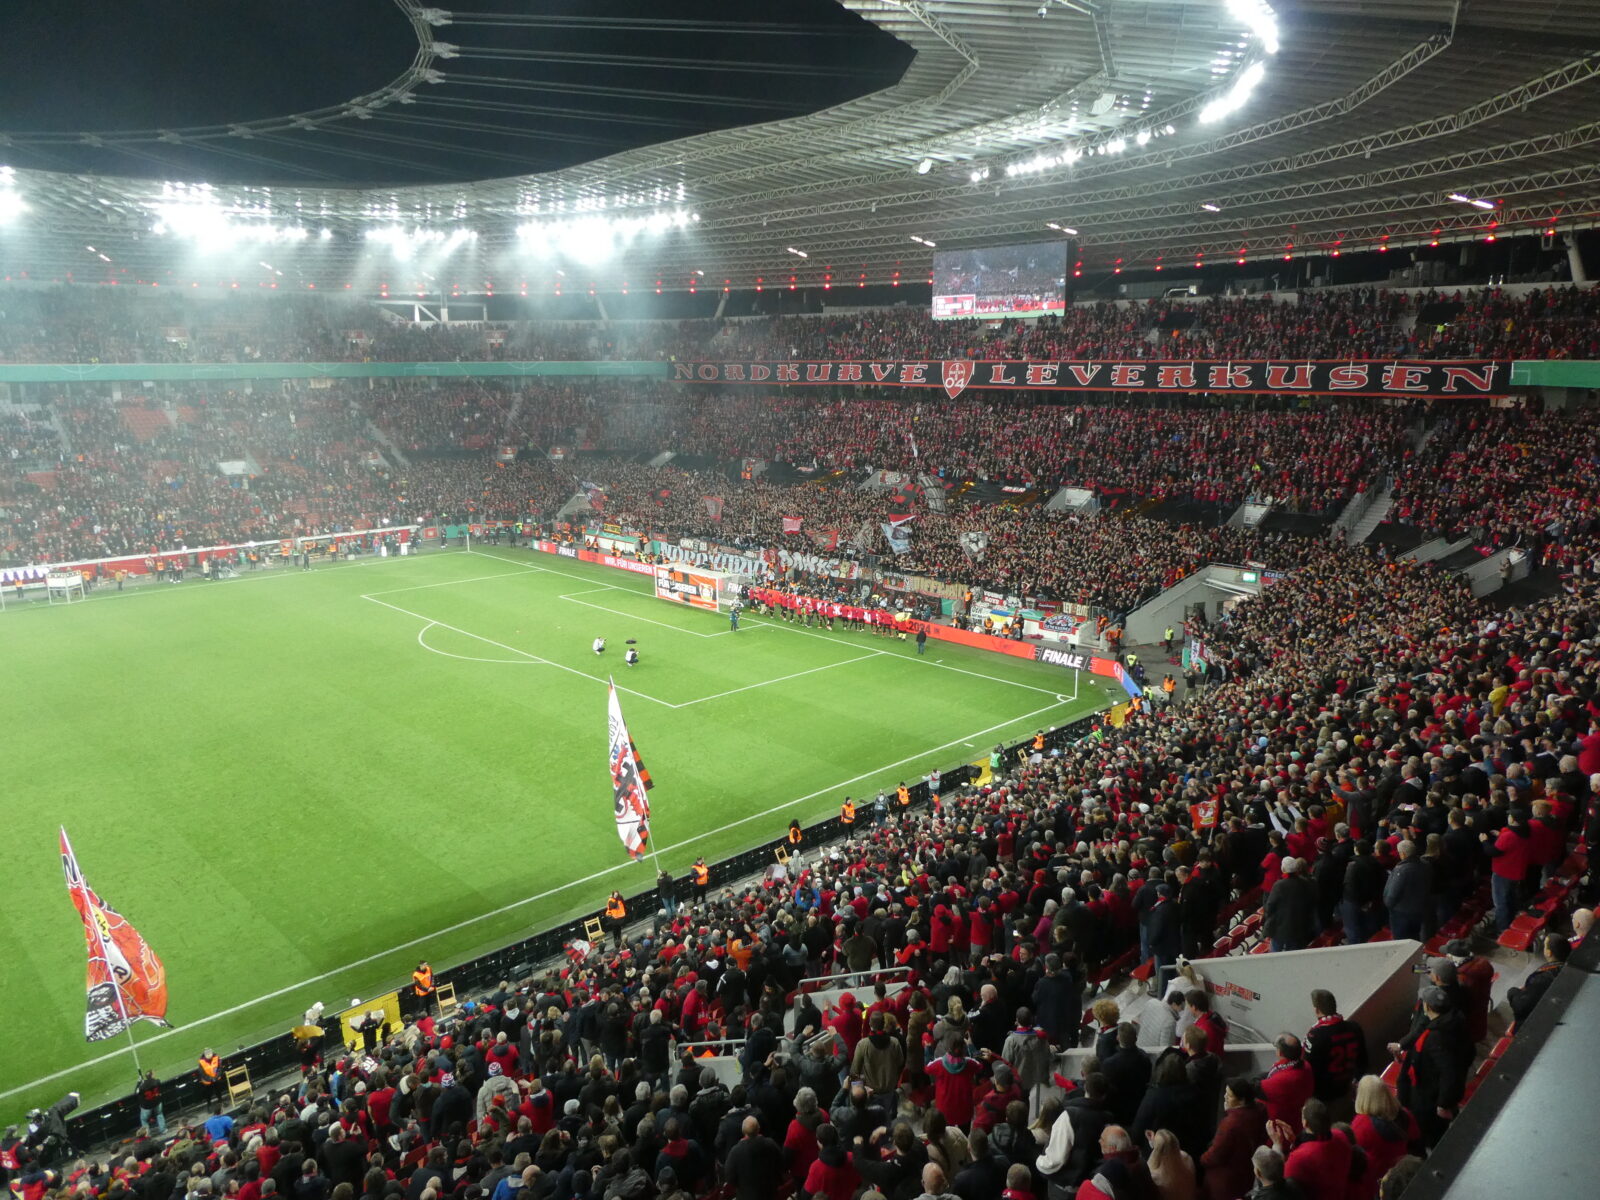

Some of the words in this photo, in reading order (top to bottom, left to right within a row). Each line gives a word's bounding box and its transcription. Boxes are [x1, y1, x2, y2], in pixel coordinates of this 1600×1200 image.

[674, 362, 928, 384] NORDKURVE
[988, 363, 1497, 392] LEVERKUSEN
[945, 377, 965, 389] 04
[559, 546, 576, 558] FINALE
[1042, 648, 1083, 668] FINALE
